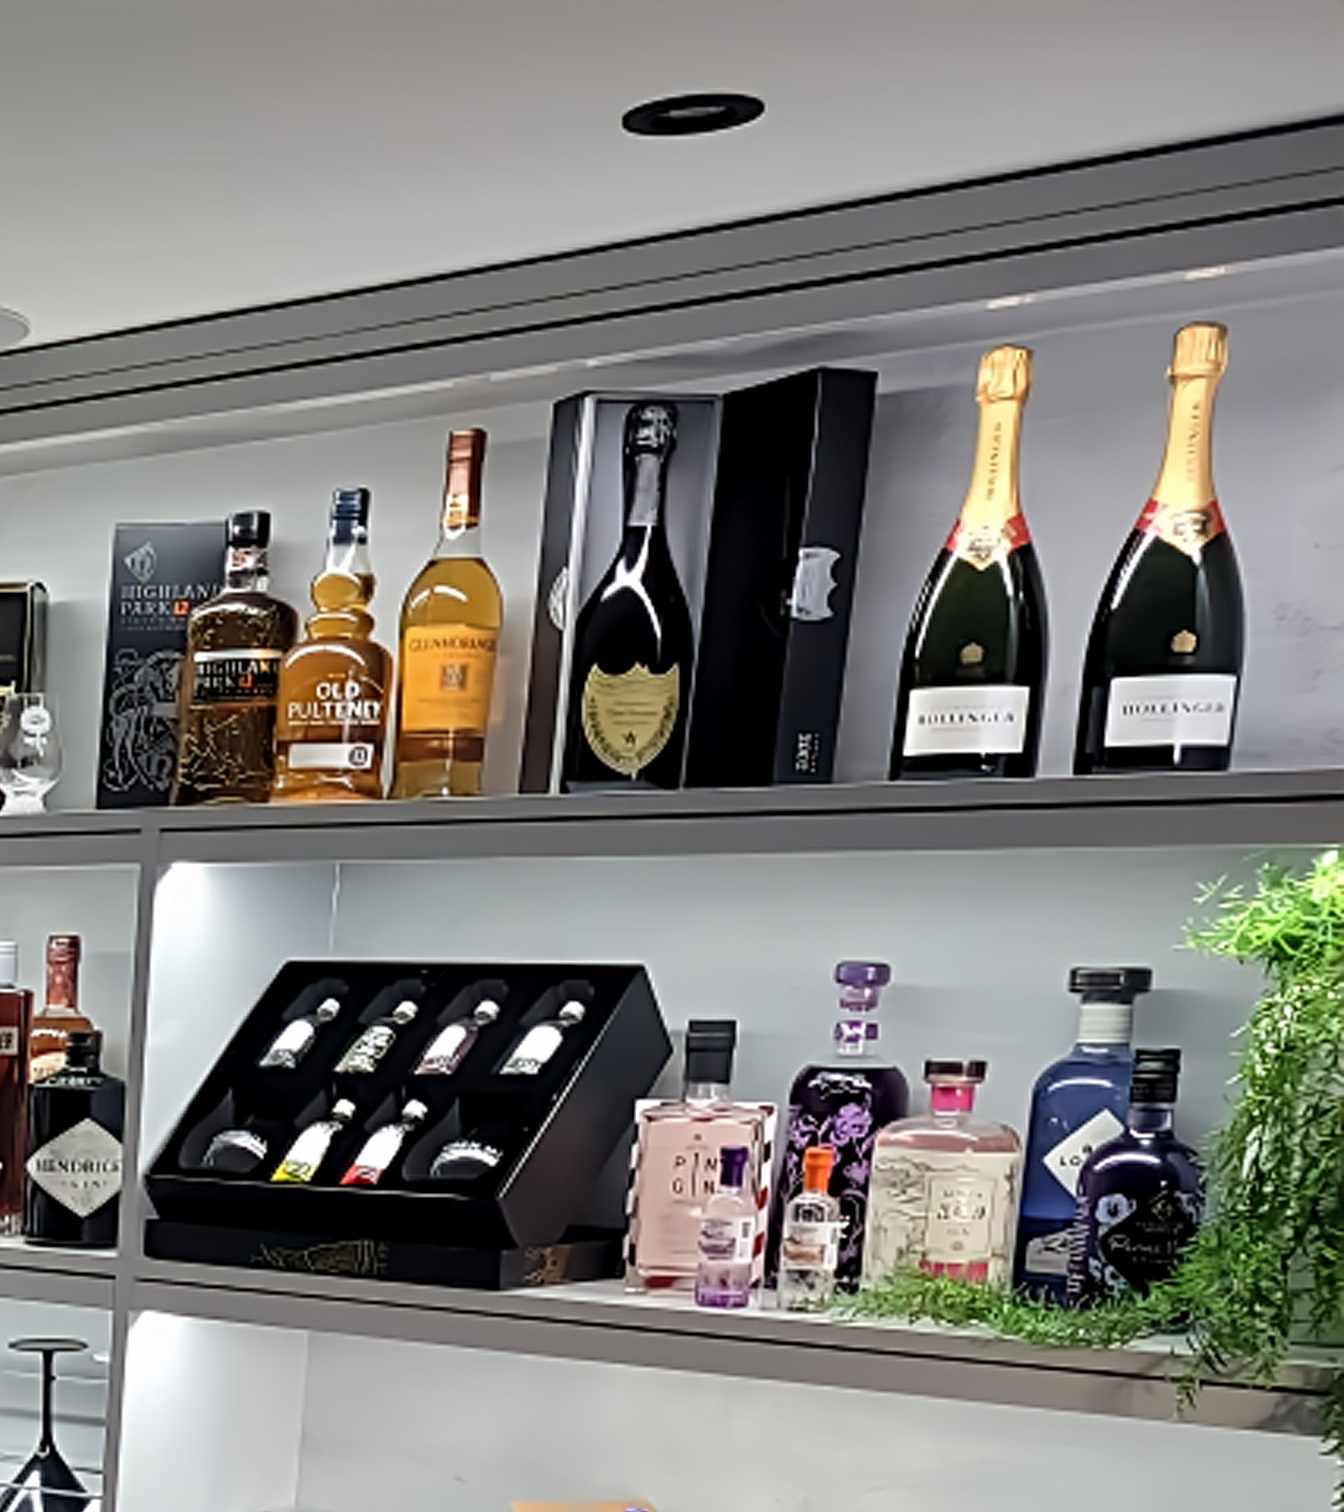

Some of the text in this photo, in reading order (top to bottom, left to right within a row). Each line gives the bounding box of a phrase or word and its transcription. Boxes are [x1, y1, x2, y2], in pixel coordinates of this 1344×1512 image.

[315, 681, 361, 700] OLD
[287, 700, 382, 719] PULTENEY
[917, 711, 1016, 726] BOLLINGER
